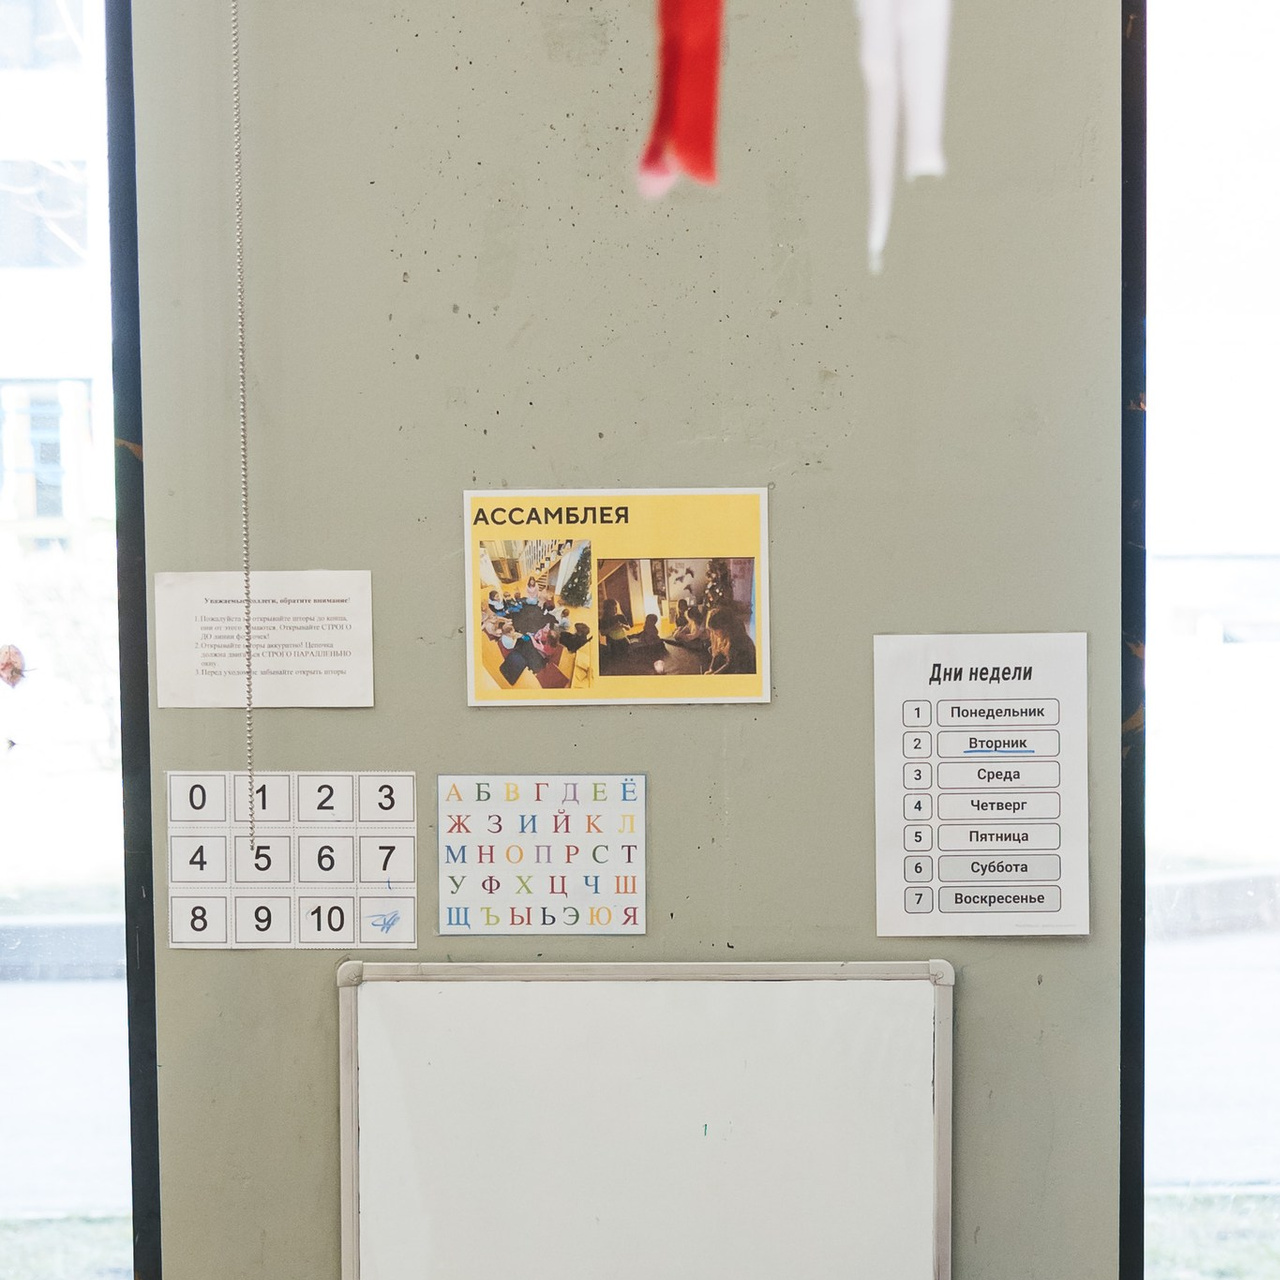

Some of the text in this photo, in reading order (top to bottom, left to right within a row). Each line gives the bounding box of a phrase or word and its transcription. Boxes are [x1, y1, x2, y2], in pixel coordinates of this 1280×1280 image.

[473, 507, 629, 525] АССАМБЛЕЯ
[280, 597, 311, 605] обратите
[929, 663, 1032, 684] Дни недели
[914, 706, 1045, 719] 1 Понедельник
[913, 738, 1027, 751] 2 Вторник
[914, 768, 1020, 782] 3 Среда
[189, 784, 395, 810] 0 1 2 3
[446, 778, 637, 805] А Б В Г Д Е Ё
[914, 800, 1027, 813] 4 Четверг
[447, 810, 635, 833] Ж З И Й К Л
[914, 830, 1029, 844] 5 Пятница
[189, 845, 395, 871] 4 5 6 7
[445, 845, 637, 864] М Н О П Р С Т
[914, 862, 1028, 876] 6 Суббота
[448, 876, 637, 898] У Ф Х Ц Ч Ш
[915, 893, 1045, 907] 7 Воскресенье
[191, 906, 344, 931] 8 9 10
[447, 906, 638, 929] Щ Ъ Ы Ь Э Ю Я
